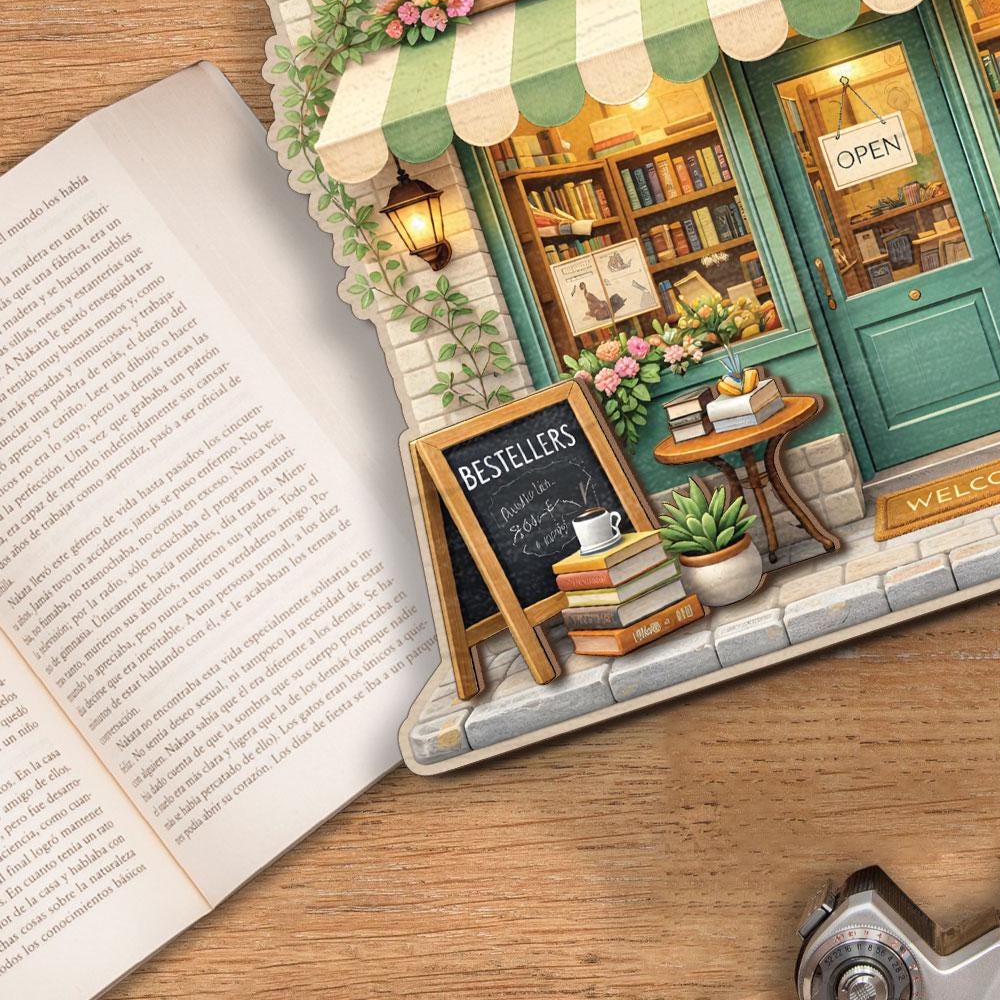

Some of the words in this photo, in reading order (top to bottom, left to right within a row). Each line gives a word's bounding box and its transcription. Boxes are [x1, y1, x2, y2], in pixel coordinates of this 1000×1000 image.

[836, 134, 904, 170] OPEN
[6, 207, 44, 237] mundo
[41, 196, 60, 210] los
[57, 174, 89, 198] había
[11, 248, 49, 278] madera
[48, 238, 63, 250] en
[62, 223, 83, 240] una
[81, 204, 110, 226] fábri-
[51, 243, 90, 270] fábrica,
[89, 229, 106, 243] era
[105, 218, 122, 231] un
[8, 327, 37, 347] sillas,
[35, 302, 66, 328] mesas
[73, 261, 124, 299] estanterías
[123, 246, 143, 263] que
[55, 262, 91, 289] hacían
[91, 232, 132, 264] muebles
[6, 369, 38, 395] tenido
[37, 351, 60, 372] muy
[57, 327, 95, 354] buenas
[94, 302, 127, 329] manos
[12, 337, 50, 367] Nakata
[47, 329, 60, 340] le
[60, 309, 88, 335] gustó
[88, 273, 137, 312] enseguida
[135, 261, 153, 276] tra-
[26, 371, 65, 405] pesadas
[72, 325, 132, 367] minuciosas,
[49, 378, 86, 410] palabra
[87, 367, 100, 380] de
[101, 350, 126, 369] más,
[126, 337, 137, 350] el
[137, 316, 169, 343] dueño
[170, 300, 188, 318] del
[52, 402, 87, 429] cariño.
[85, 382, 109, 402] Leer
[110, 371, 126, 384] un
[126, 345, 159, 373] dibujo
[89, 402, 114, 425] pero
[112, 391, 130, 404] las
[130, 366, 163, 392] demás
[163, 344, 193, 368] tareas
[191, 332, 209, 345] las
[13, 465, 63, 509] perfección.
[63, 444, 88, 463] Una
[89, 430, 106, 444] vez
[109, 414, 128, 432] que
[130, 384, 169, 418] grababa
[169, 372, 186, 386] un
[186, 346, 220, 376] patrón
[58, 458, 100, 492] repetirlo
[99, 398, 179, 460] indefinidamente
[179, 387, 196, 400] sin
[165, 447, 204, 482] pasados
[202, 435, 221, 450] los
[221, 404, 263, 438] cincuen-
[457, 423, 578, 492] BESTELLERS
[40, 499, 76, 531] trabajar
[76, 478, 104, 502] como
[105, 445, 150, 481] aprendiz,
[149, 424, 173, 448] pasó
[150, 519, 199, 559] escuchaba
[200, 507, 211, 521] el
[212, 475, 260, 515] programa
[260, 447, 296, 477] matuti-
[197, 474, 232, 501] exceso.
[229, 447, 265, 475] Nunca
[264, 433, 286, 449] veía
[86, 527, 133, 564] accidente,
[131, 503, 161, 529] jamás
[175, 529, 220, 563] muebles,
[219, 514, 237, 529] día
[236, 499, 257, 516] tras
[257, 486, 274, 501] día.
[275, 462, 307, 486] Mien-
[140, 582, 180, 615] abuelos,
[179, 544, 226, 583] murieron
[226, 532, 244, 545] sus
[244, 507, 277, 536] padres.
[157, 596, 188, 623] nunca
[187, 578, 212, 598] tuvo
[211, 566, 228, 580] un
[227, 529, 277, 568] verdadero
[278, 506, 309, 532] amigo.
[215, 569, 255, 603] persona
[254, 538, 295, 571] normal,
[244, 565, 290, 602] acababan
[288, 552, 307, 567] los
[307, 530, 337, 554] temas
[297, 588, 346, 630] necesidad
[346, 580, 360, 593] de
[361, 561, 384, 582] estar
[243, 595, 310, 648] especialmente
[310, 565, 350, 597] solitaria
[265, 642, 307, 678] diferente
[312, 625, 331, 639] los
[331, 601, 362, 627] demás.
[304, 642, 338, 671] cuerpo
[339, 601, 393, 646] proyectaba
[393, 591, 407, 603] en
[317, 657, 350, 683] demás
[348, 626, 389, 660] (aunque
[389, 605, 418, 629] nadie
[139, 645, 185, 682] hablando
[299, 697, 325, 724] gatos
[324, 681, 347, 701] eran
[46, 778, 81, 804] desarro-
[5, 853, 31, 877] final
[29, 836, 59, 859] logró
[67, 846, 108, 876] hablaba
[21, 940, 40, 956] los
[40, 886, 114, 942] conocimientos
